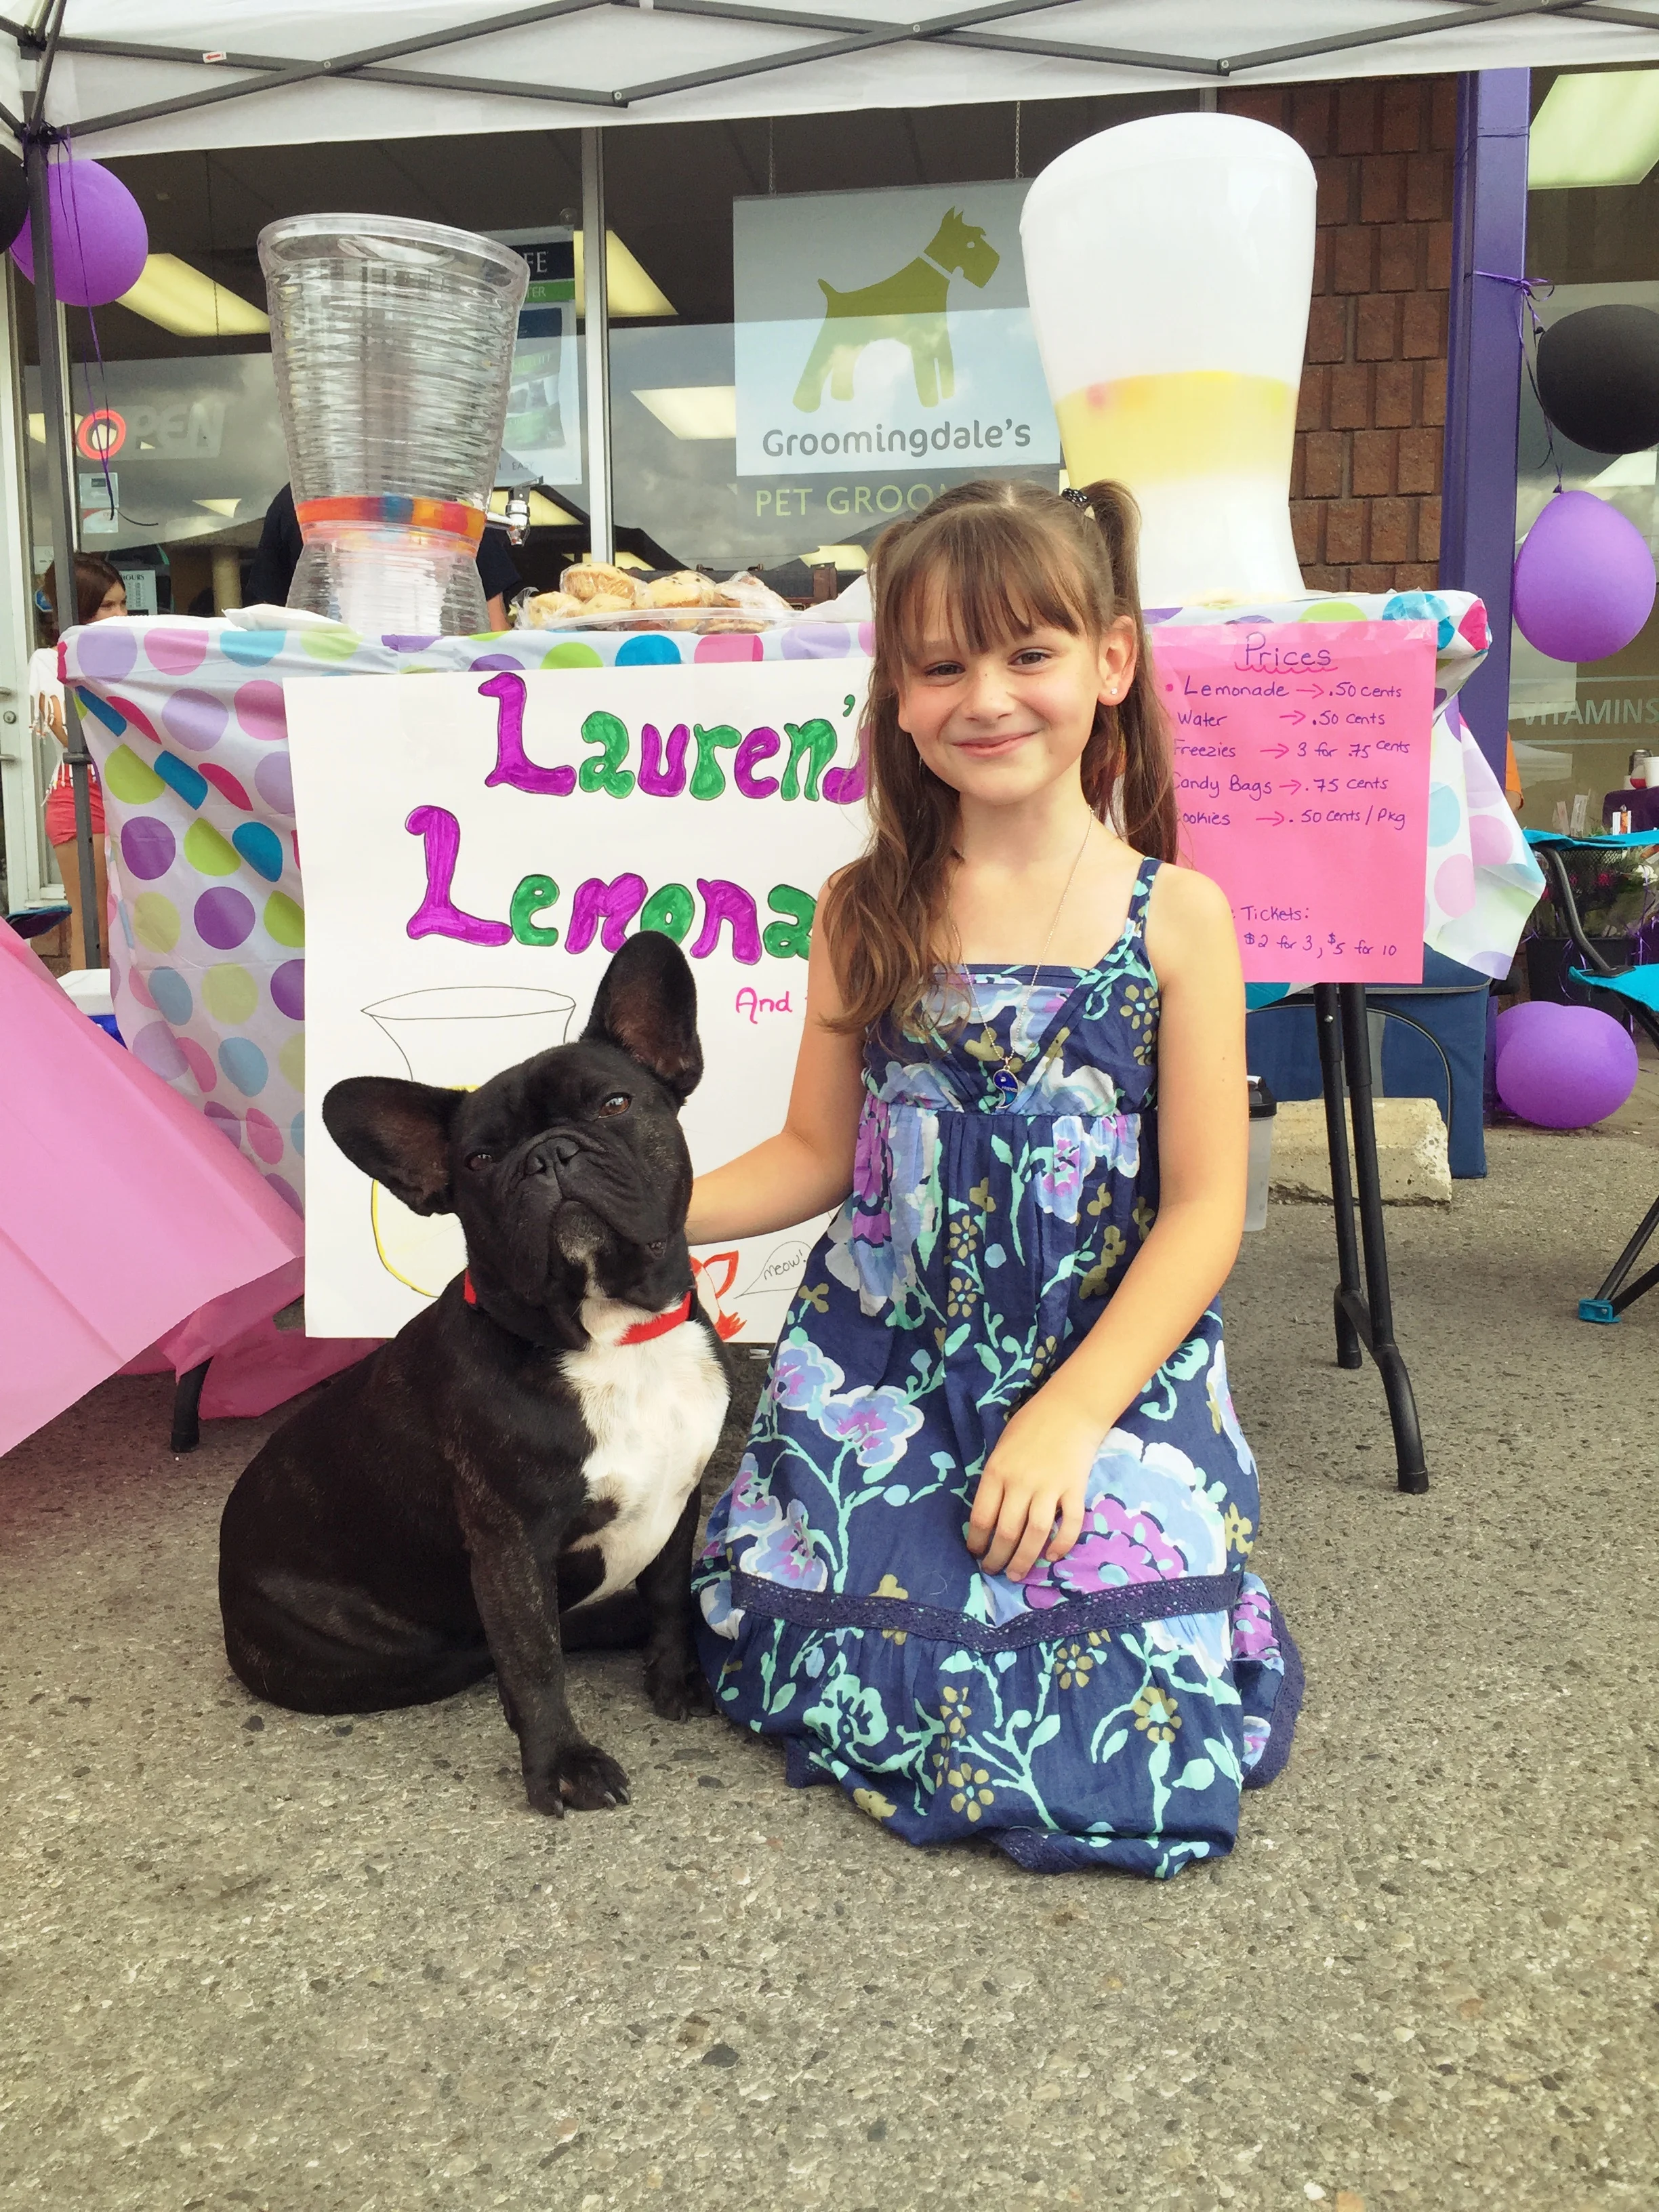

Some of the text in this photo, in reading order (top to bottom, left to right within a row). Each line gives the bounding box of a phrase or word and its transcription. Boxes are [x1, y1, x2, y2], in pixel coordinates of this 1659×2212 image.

[523, 250, 548, 274] FE
[77, 403, 226, 460] OPEN
[762, 419, 1031, 457] Groomingdale's
[756, 483, 946, 516] PET GROO
[1246, 631, 1332, 666] Prices
[1184, 675, 1290, 697] Lemonade
[1329, 681, 1356, 697] .50
[1178, 710, 1386, 727] Water .50 cents
[1174, 738, 1411, 759] Freezies 3 for .75 cents
[1229, 774, 1272, 801] Bags
[1347, 777, 1389, 790] cents
[1182, 811, 1231, 825] ookies
[405, 805, 817, 964] Lemona
[1241, 905, 1309, 922] Tickets:
[1244, 932, 1269, 948] $2
[1277, 935, 1297, 949] for
[1328, 932, 1345, 955] $5
[1354, 939, 1374, 955] for
[1382, 944, 1397, 956] 10
[735, 987, 793, 1025] And
